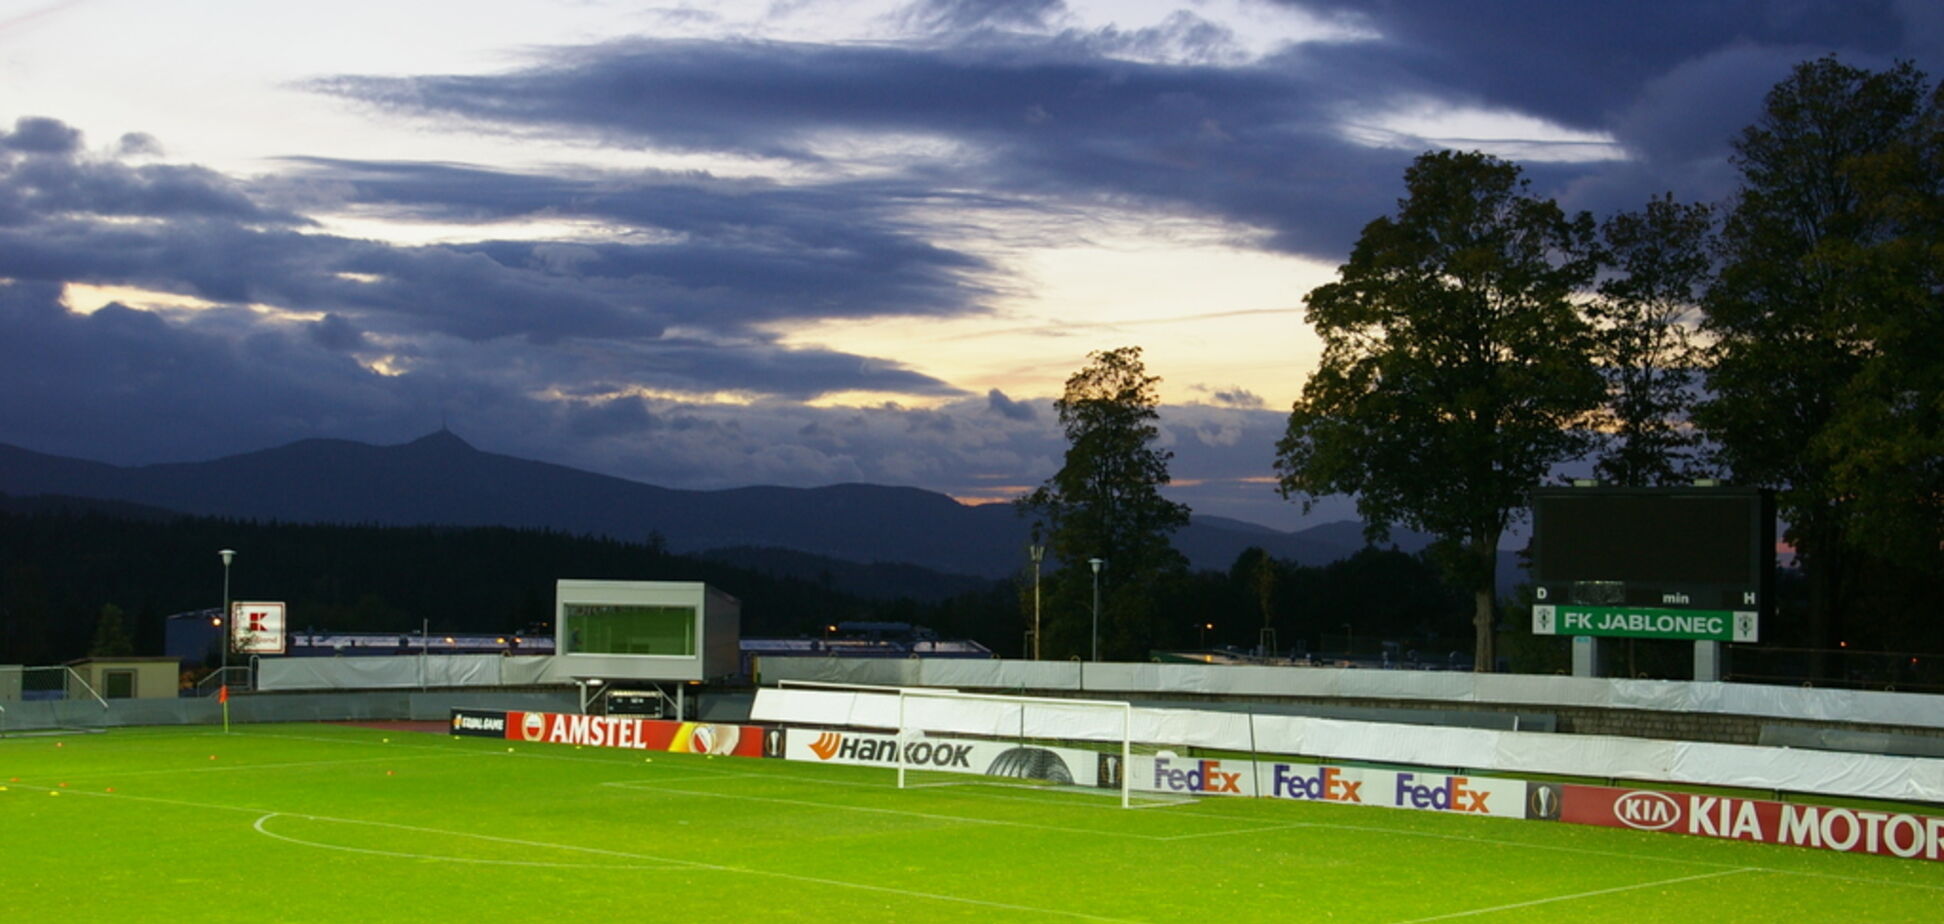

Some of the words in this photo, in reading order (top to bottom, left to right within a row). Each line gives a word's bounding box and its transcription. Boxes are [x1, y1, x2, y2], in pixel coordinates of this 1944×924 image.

[1536, 586, 1548, 600] D
[1663, 592, 1689, 604] min
[1743, 592, 1756, 605] H
[250, 612, 268, 631] K
[1564, 612, 1593, 630] FK
[1598, 613, 1723, 634] JABLONEC
[550, 713, 647, 749] AMSTEL
[1154, 757, 1242, 794] FedEx
[1273, 764, 1363, 803] FedEx
[1395, 772, 1491, 814] FedEx
[1625, 799, 1669, 822] KIA
[1689, 795, 1764, 841] KIA
